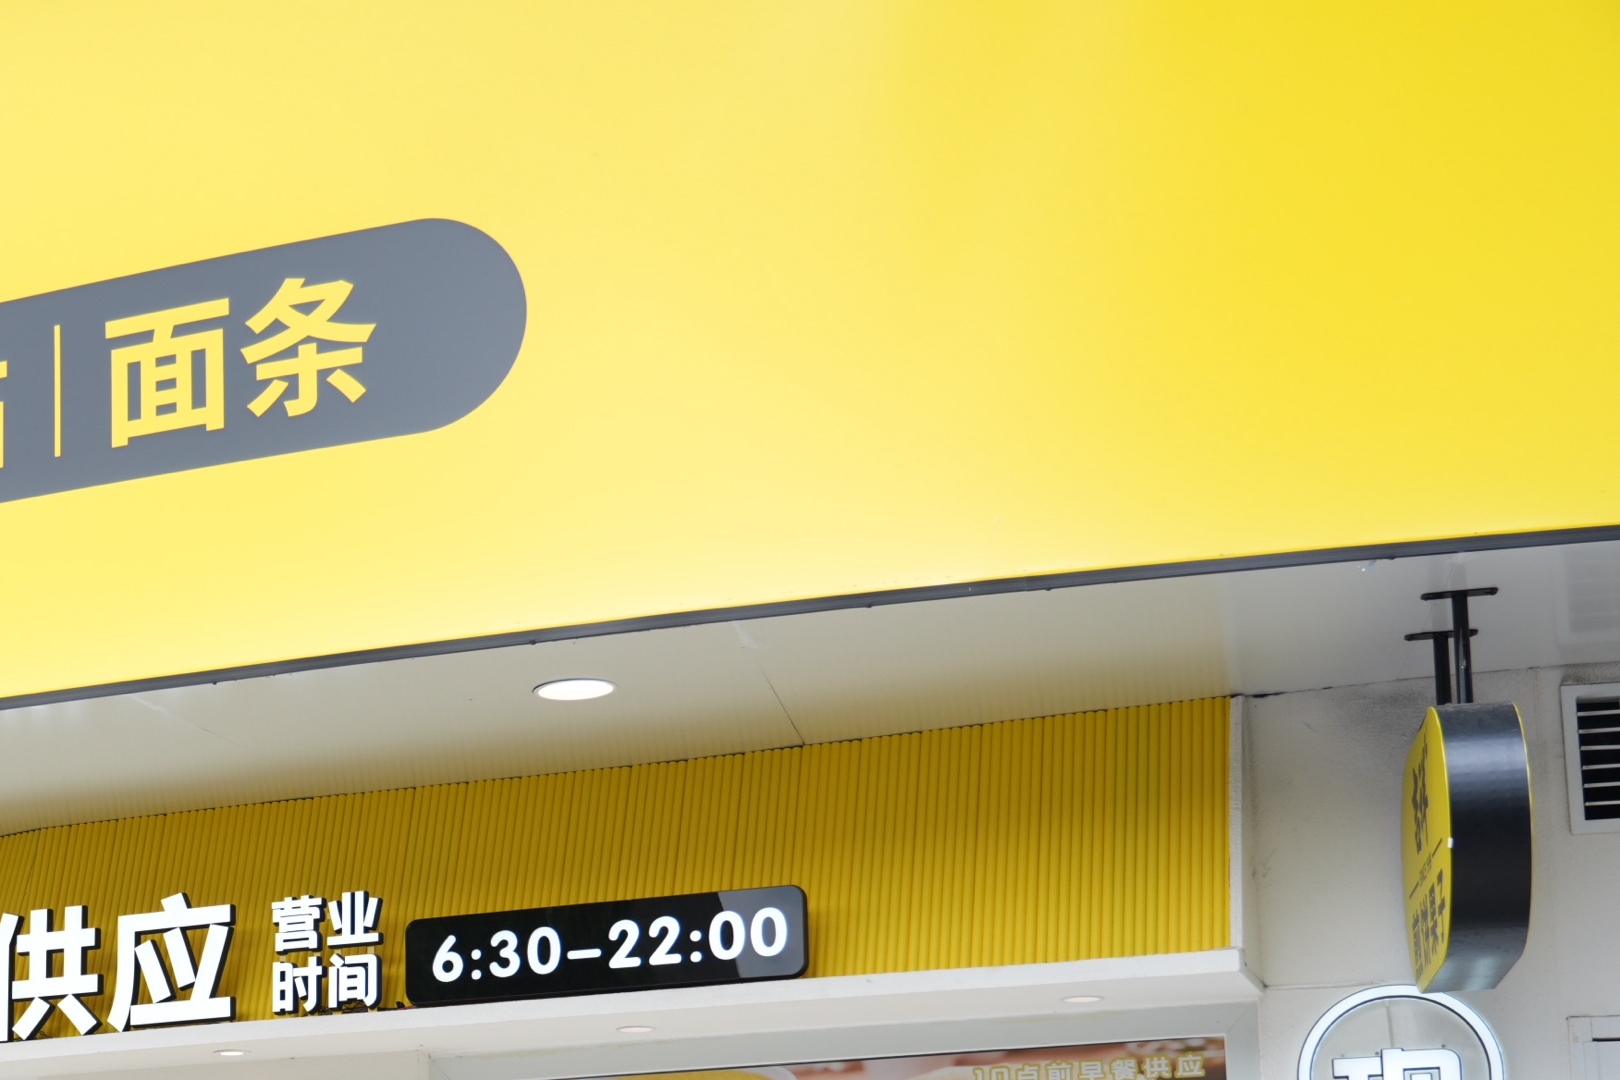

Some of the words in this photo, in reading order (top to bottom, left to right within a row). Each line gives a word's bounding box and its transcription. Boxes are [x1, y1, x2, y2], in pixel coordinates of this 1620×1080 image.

[104, 276, 377, 451] 面条
[270, 889, 382, 955] 营业
[271, 950, 381, 1018] 时间
